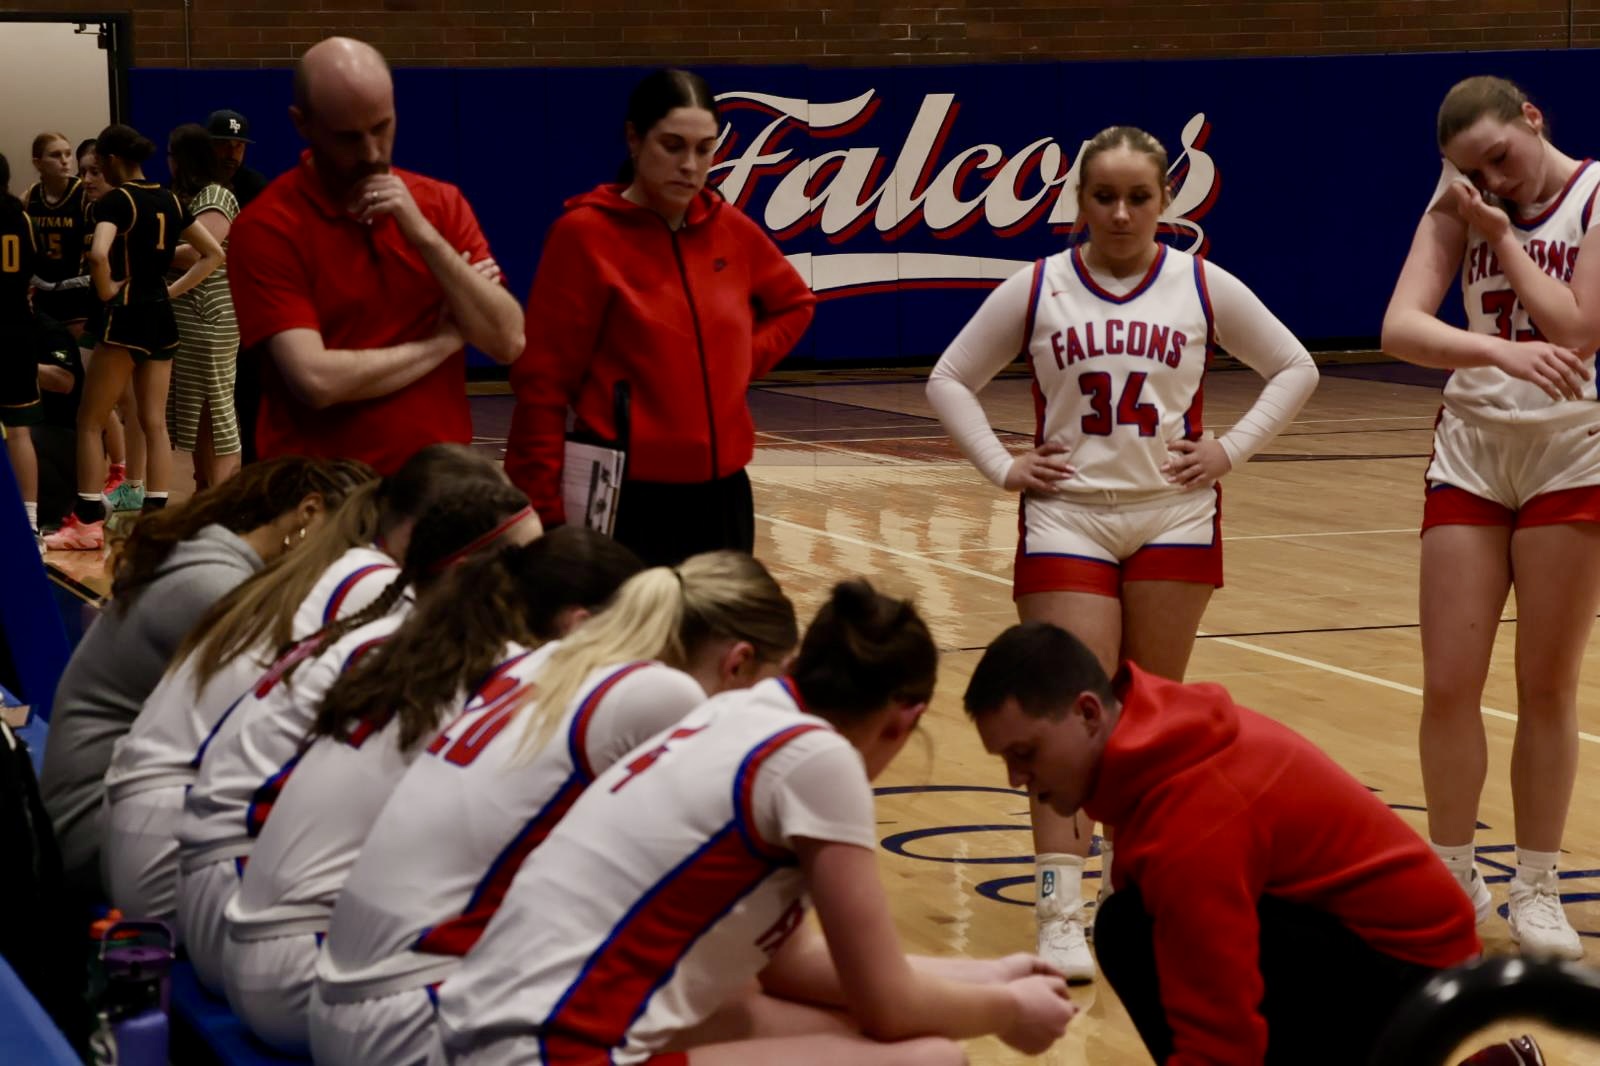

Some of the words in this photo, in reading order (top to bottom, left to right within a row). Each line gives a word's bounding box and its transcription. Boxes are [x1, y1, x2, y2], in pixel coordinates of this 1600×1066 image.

[155, 211, 166, 250] 1
[1051, 319, 1187, 370] FALCONS
[1078, 371, 1159, 437] 34
